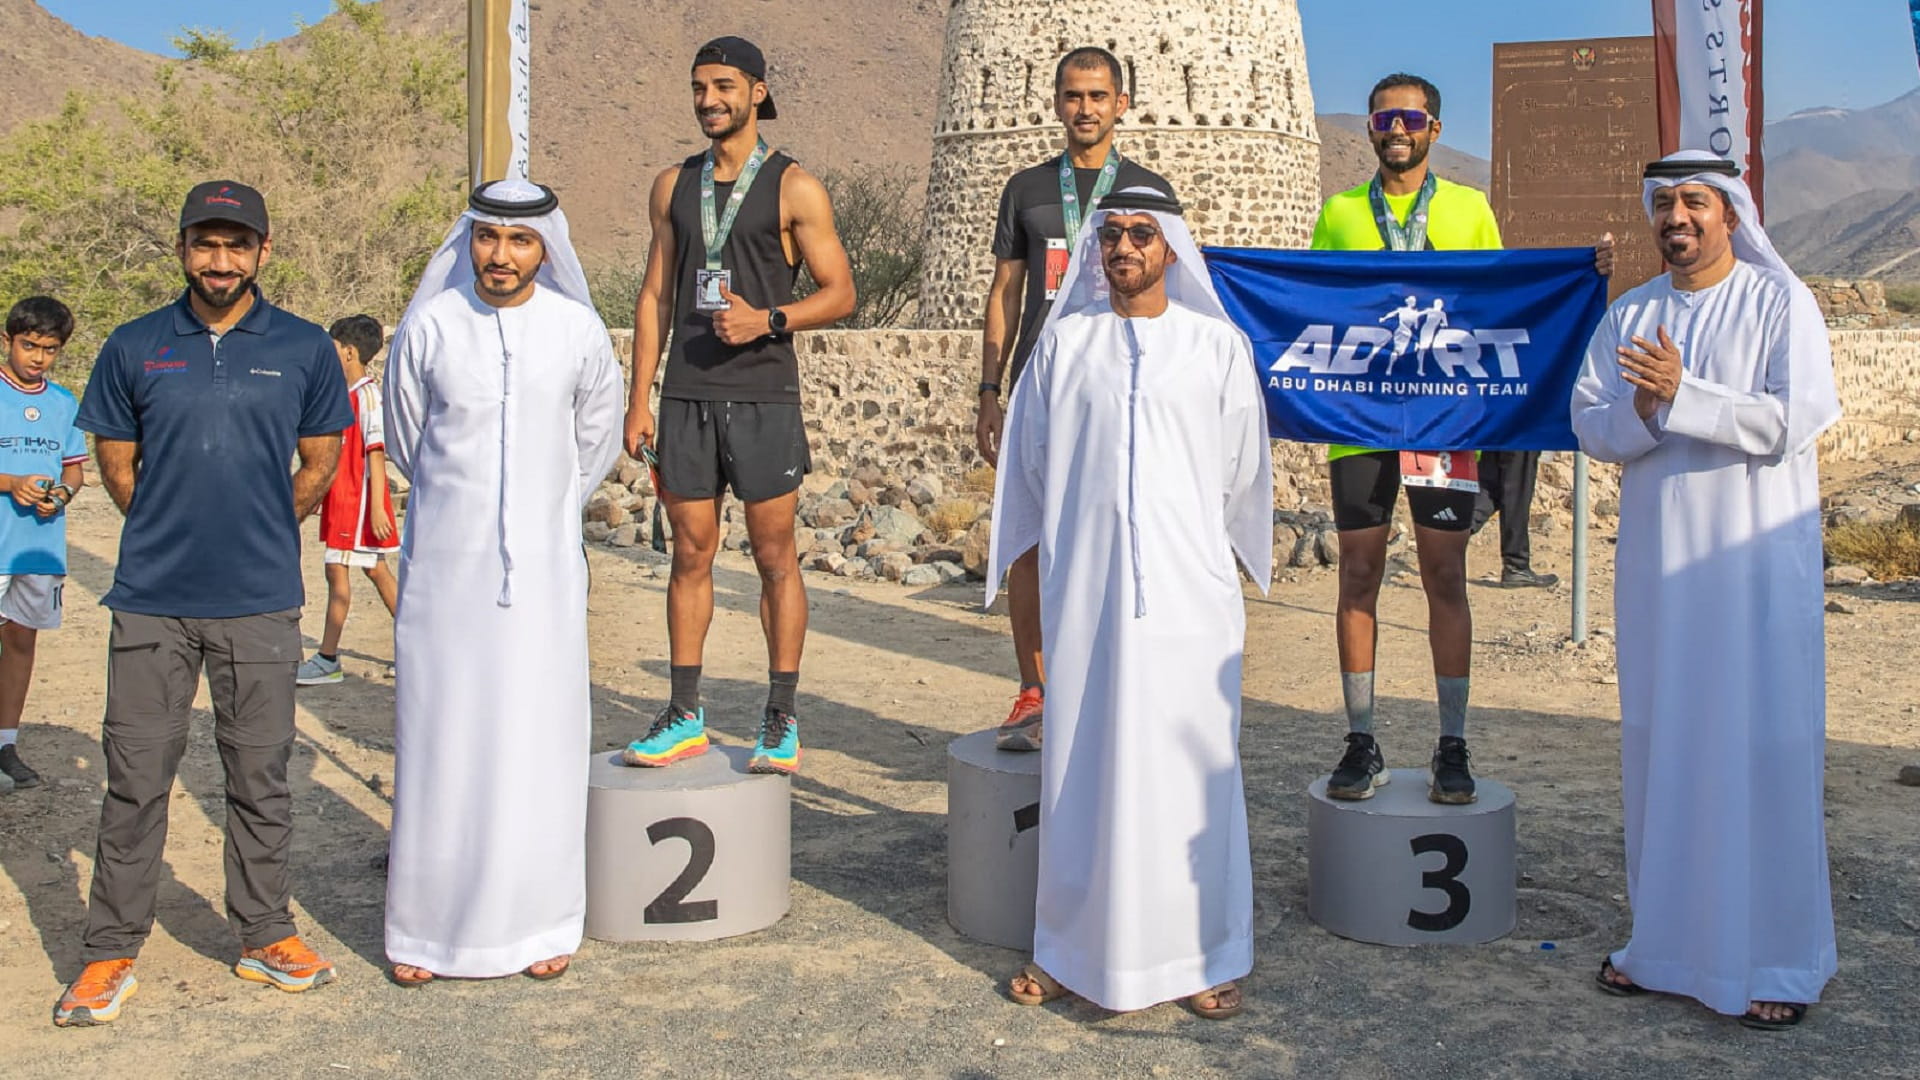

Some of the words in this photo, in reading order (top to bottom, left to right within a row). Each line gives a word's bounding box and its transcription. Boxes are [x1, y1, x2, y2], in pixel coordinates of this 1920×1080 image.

[1268, 376, 1308, 391] ABU
[1314, 379, 1374, 393] DHABI
[1381, 381, 1469, 396] RUNNING
[1476, 383, 1529, 396] TEAM
[644, 816, 719, 924] 2
[1406, 833, 1471, 932] 3
